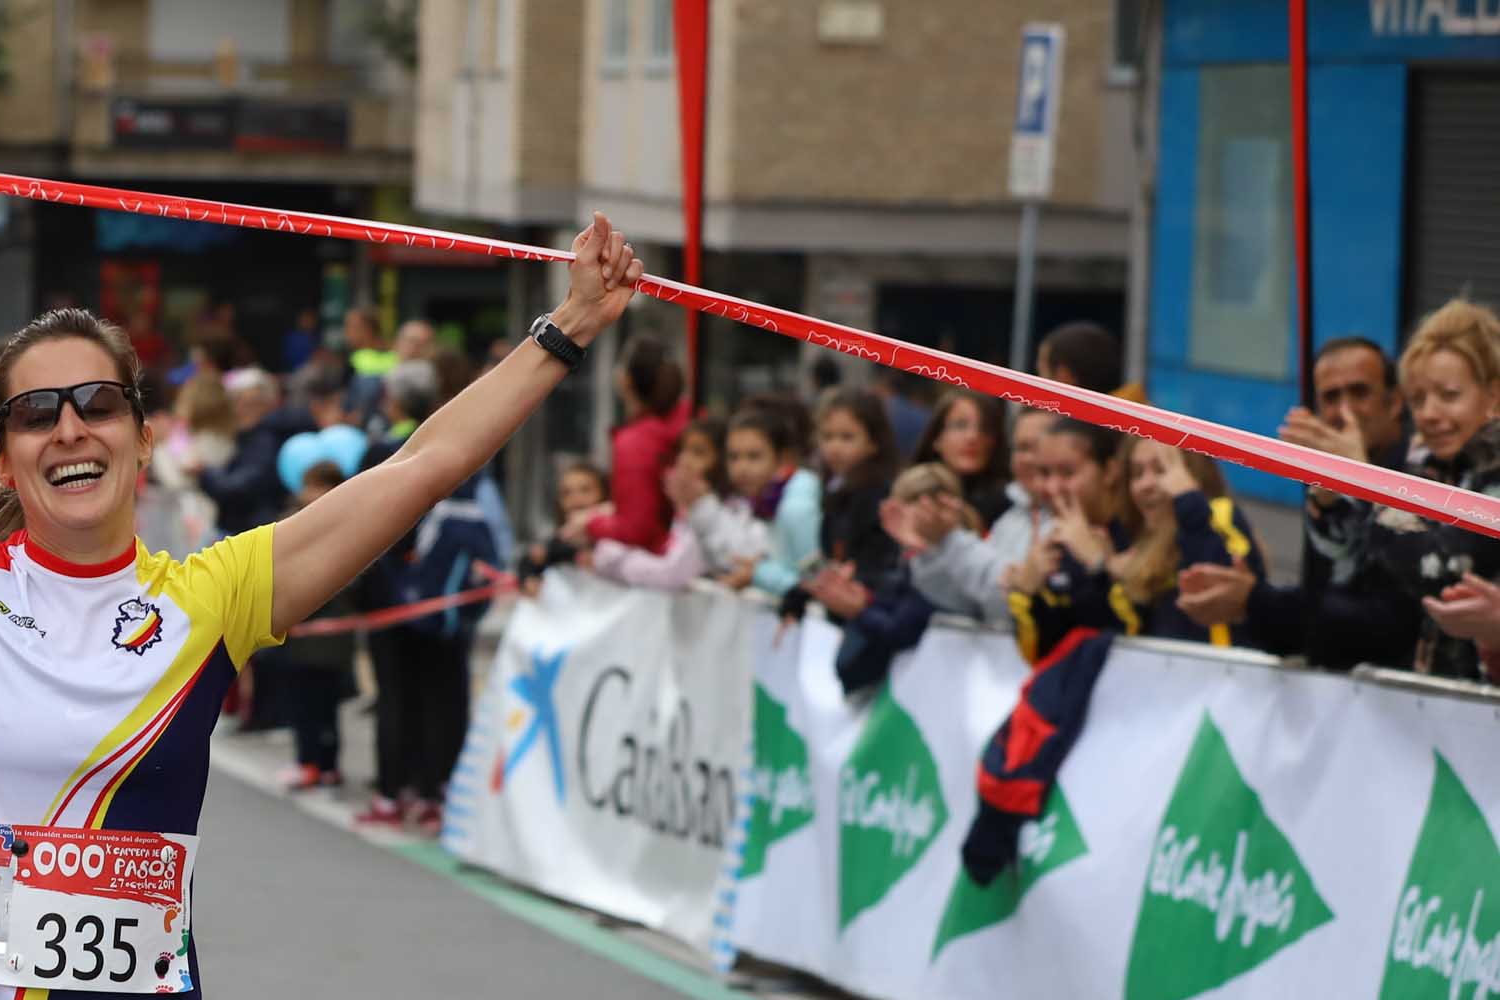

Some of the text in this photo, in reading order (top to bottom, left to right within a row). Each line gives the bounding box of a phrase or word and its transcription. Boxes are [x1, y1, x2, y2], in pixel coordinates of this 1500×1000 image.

[24, 831, 61, 839] inclusión
[62, 832, 85, 840] social
[97, 834, 120, 842] través
[134, 837, 159, 845] deporte
[114, 857, 177, 880] PASOS
[109, 877, 125, 889] 27
[34, 912, 140, 983] 335
